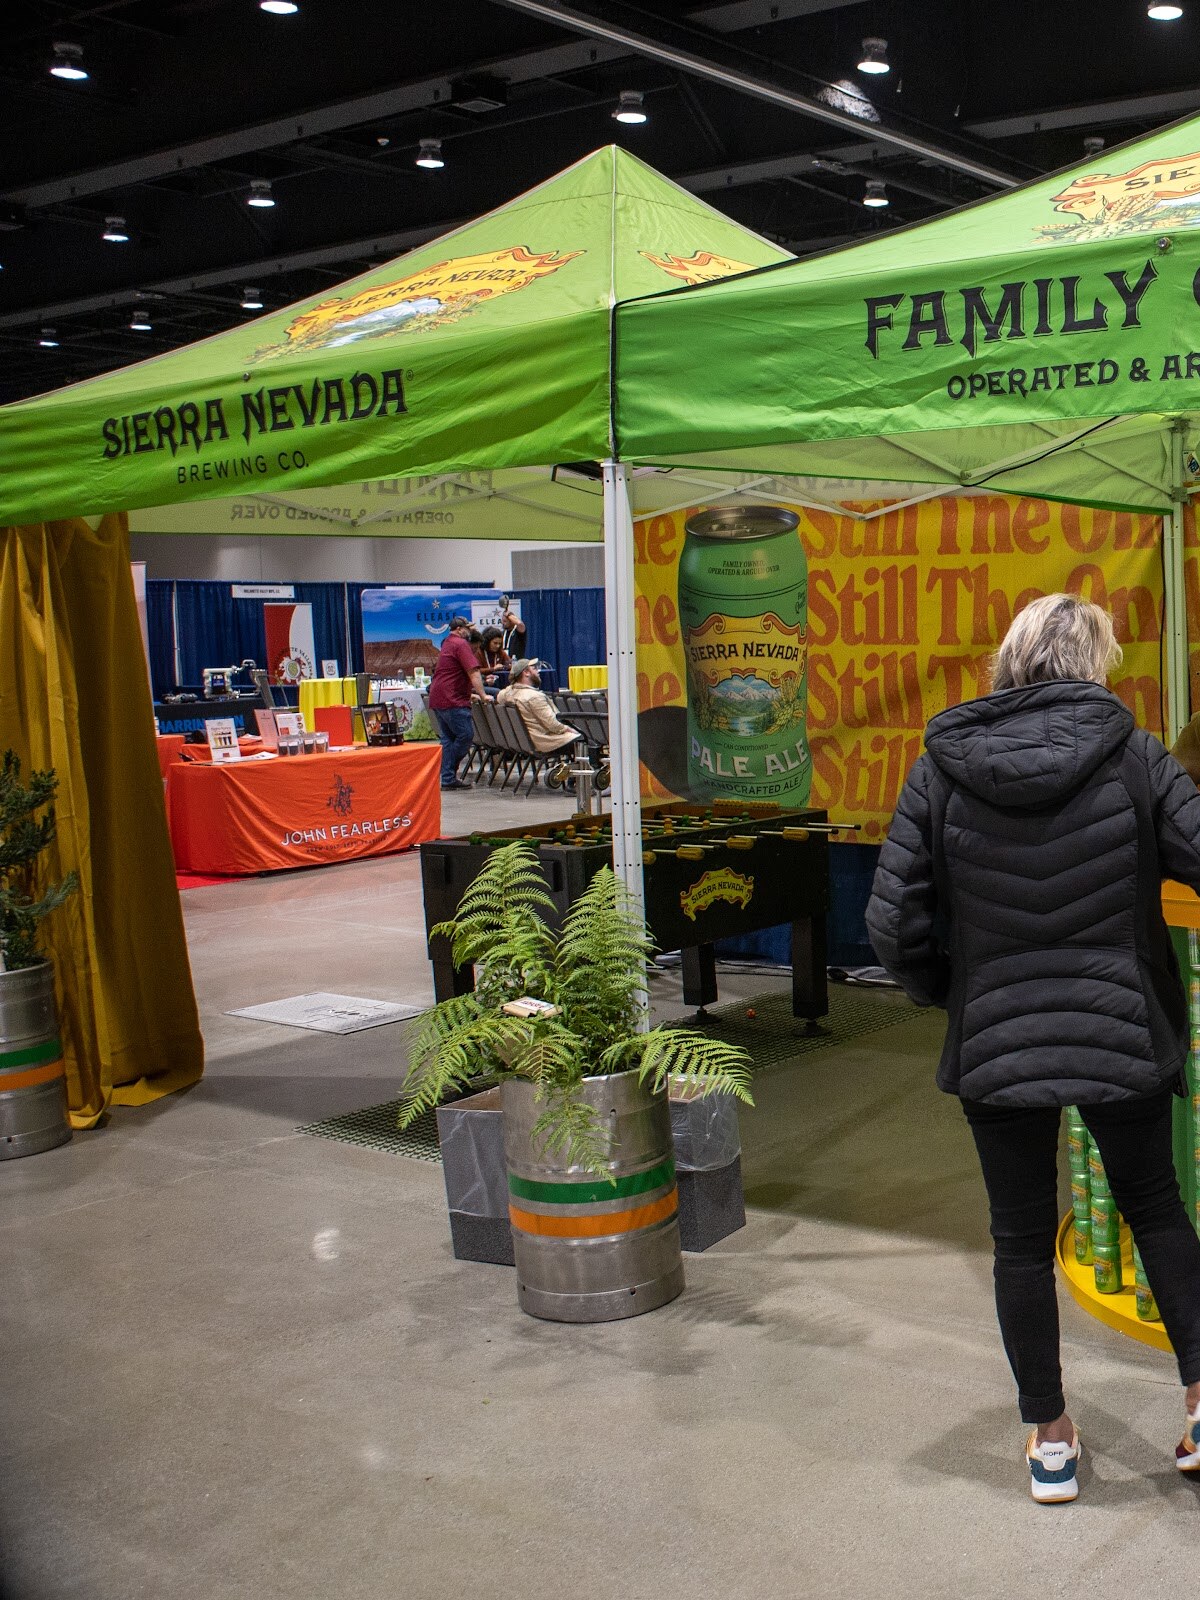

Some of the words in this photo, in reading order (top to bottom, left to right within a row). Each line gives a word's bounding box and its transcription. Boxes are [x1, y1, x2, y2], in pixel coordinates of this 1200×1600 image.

[334, 277, 441, 315] SIERRA
[438, 268, 527, 286] NEVADA
[864, 258, 1159, 360] FAMILY
[947, 357, 1120, 401] OPERATED
[1128, 356, 1151, 383] &
[102, 396, 231, 460] SIERRA
[176, 456, 268, 485] BREWING
[277, 450, 310, 471] CO.
[798, 496, 920, 559] Still
[934, 494, 1051, 556] The
[707, 566, 736, 576] OPERATED
[735, 566, 741, 576] &
[766, 564, 781, 572] OVER
[722, 560, 744, 568] FAMILY
[807, 563, 920, 646] Still
[925, 562, 1046, 646] Th
[690, 643, 739, 662] SIERRA
[742, 640, 800, 662] NEVADA
[806, 651, 924, 730] Still
[690, 735, 757, 779] PALE
[764, 737, 809, 777] ALE
[734, 743, 769, 751] CONDITIONED
[702, 779, 781, 796] HANDCRAFTED
[783, 776, 800, 791] ALE
[281, 827, 327, 847] JOHN
[330, 814, 413, 840] FEARLESS
[691, 883, 717, 904] SIERRA
[717, 881, 745, 893] NEVADA
